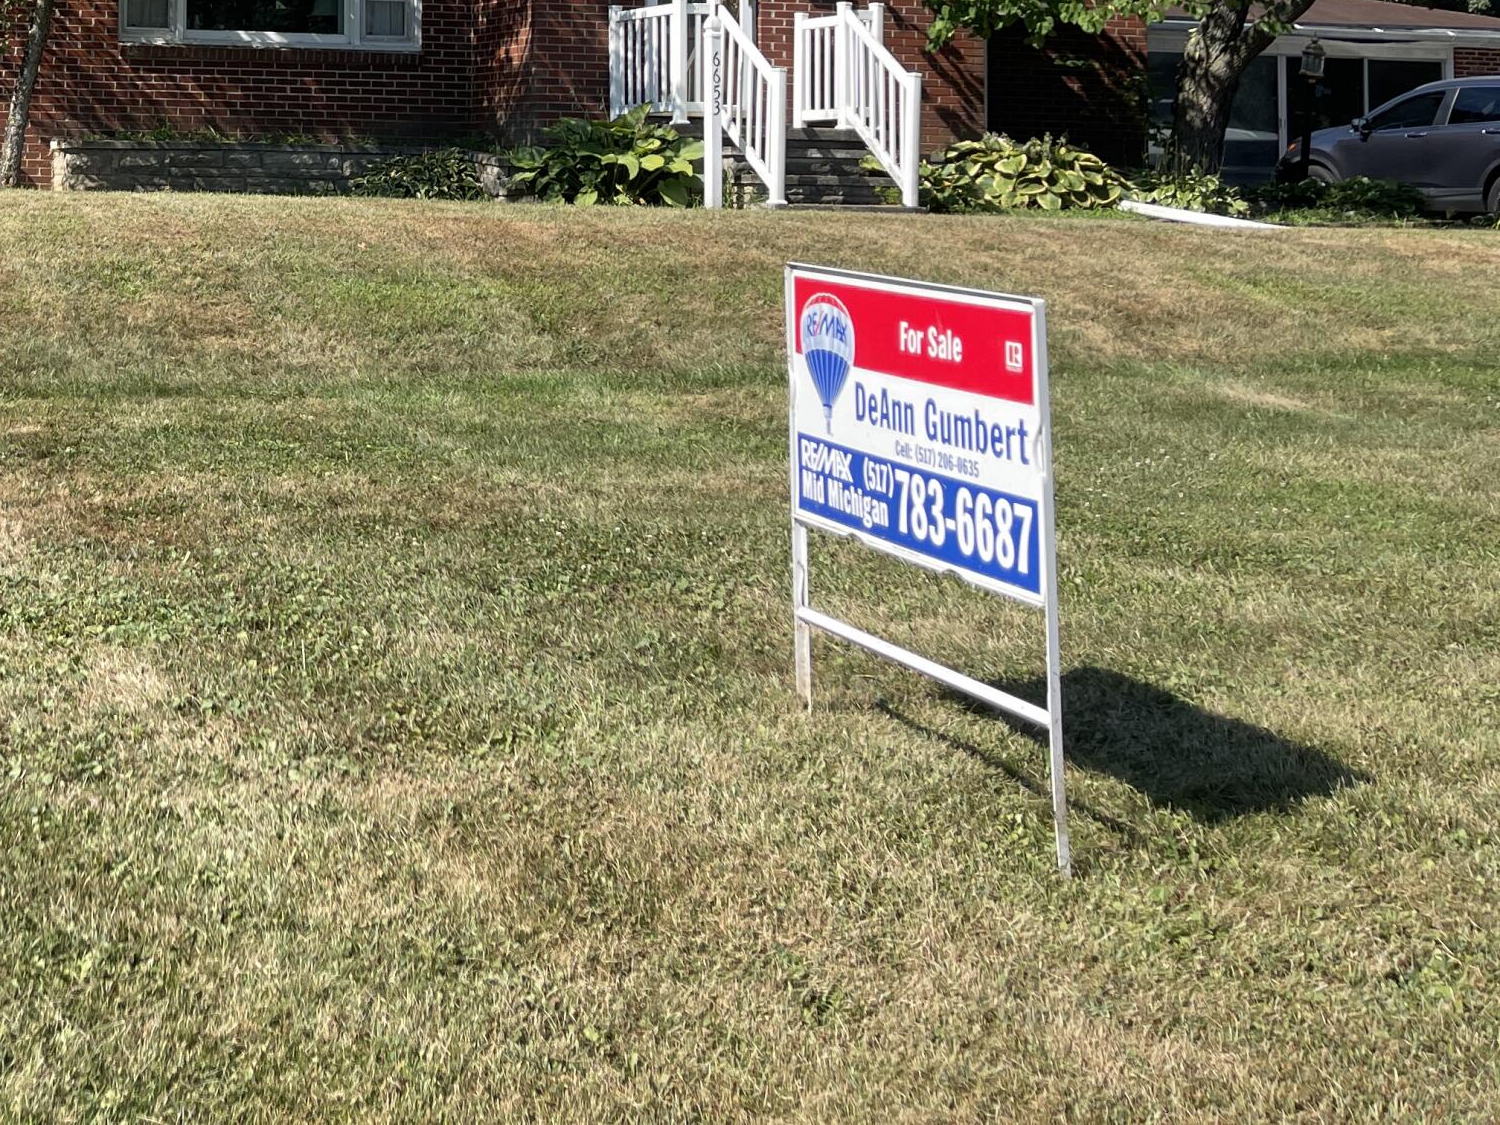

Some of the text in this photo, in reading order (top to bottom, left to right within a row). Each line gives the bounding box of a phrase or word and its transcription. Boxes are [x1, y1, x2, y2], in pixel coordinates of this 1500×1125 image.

[712, 51, 721, 116] 6653
[807, 311, 848, 344] RE/MAX
[900, 321, 962, 363] For Sale
[854, 381, 1030, 466] DeAnn Gumbert
[801, 438, 853, 483] RE/MAX
[895, 439, 981, 478] Cell: (517) 206-0635
[802, 469, 890, 529] Mid Michigan
[863, 457, 1033, 574] (517) 783-6687
